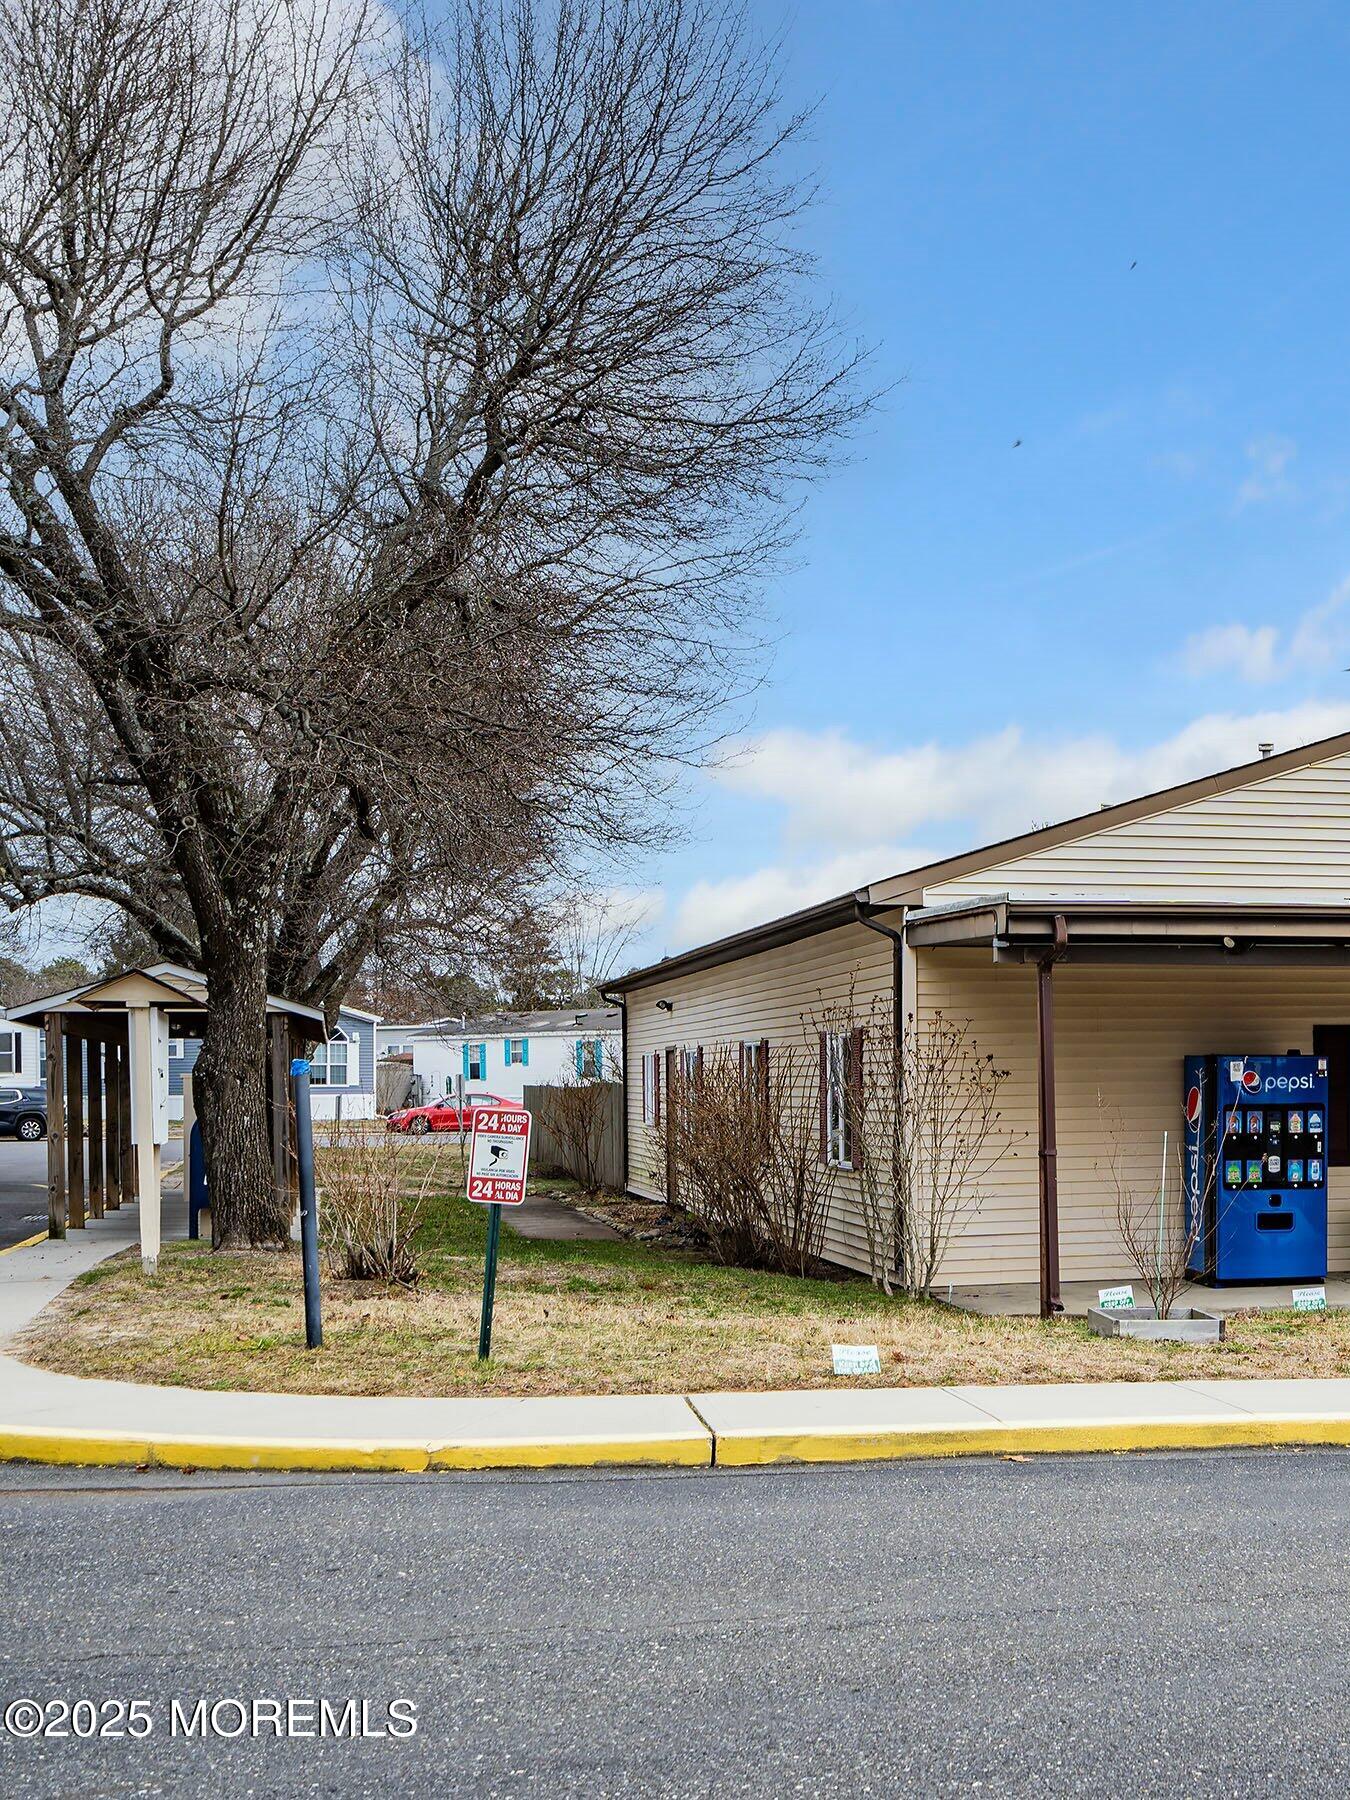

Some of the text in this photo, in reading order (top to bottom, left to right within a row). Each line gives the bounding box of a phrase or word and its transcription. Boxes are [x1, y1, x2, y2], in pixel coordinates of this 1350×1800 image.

[1265, 1073, 1313, 1092] pepsi
[478, 1113, 528, 1131] 24 HOURS
[500, 1123, 523, 1133] A DAY
[471, 1180, 521, 1198] 24 HORAS
[495, 1190, 505, 1199] AL
